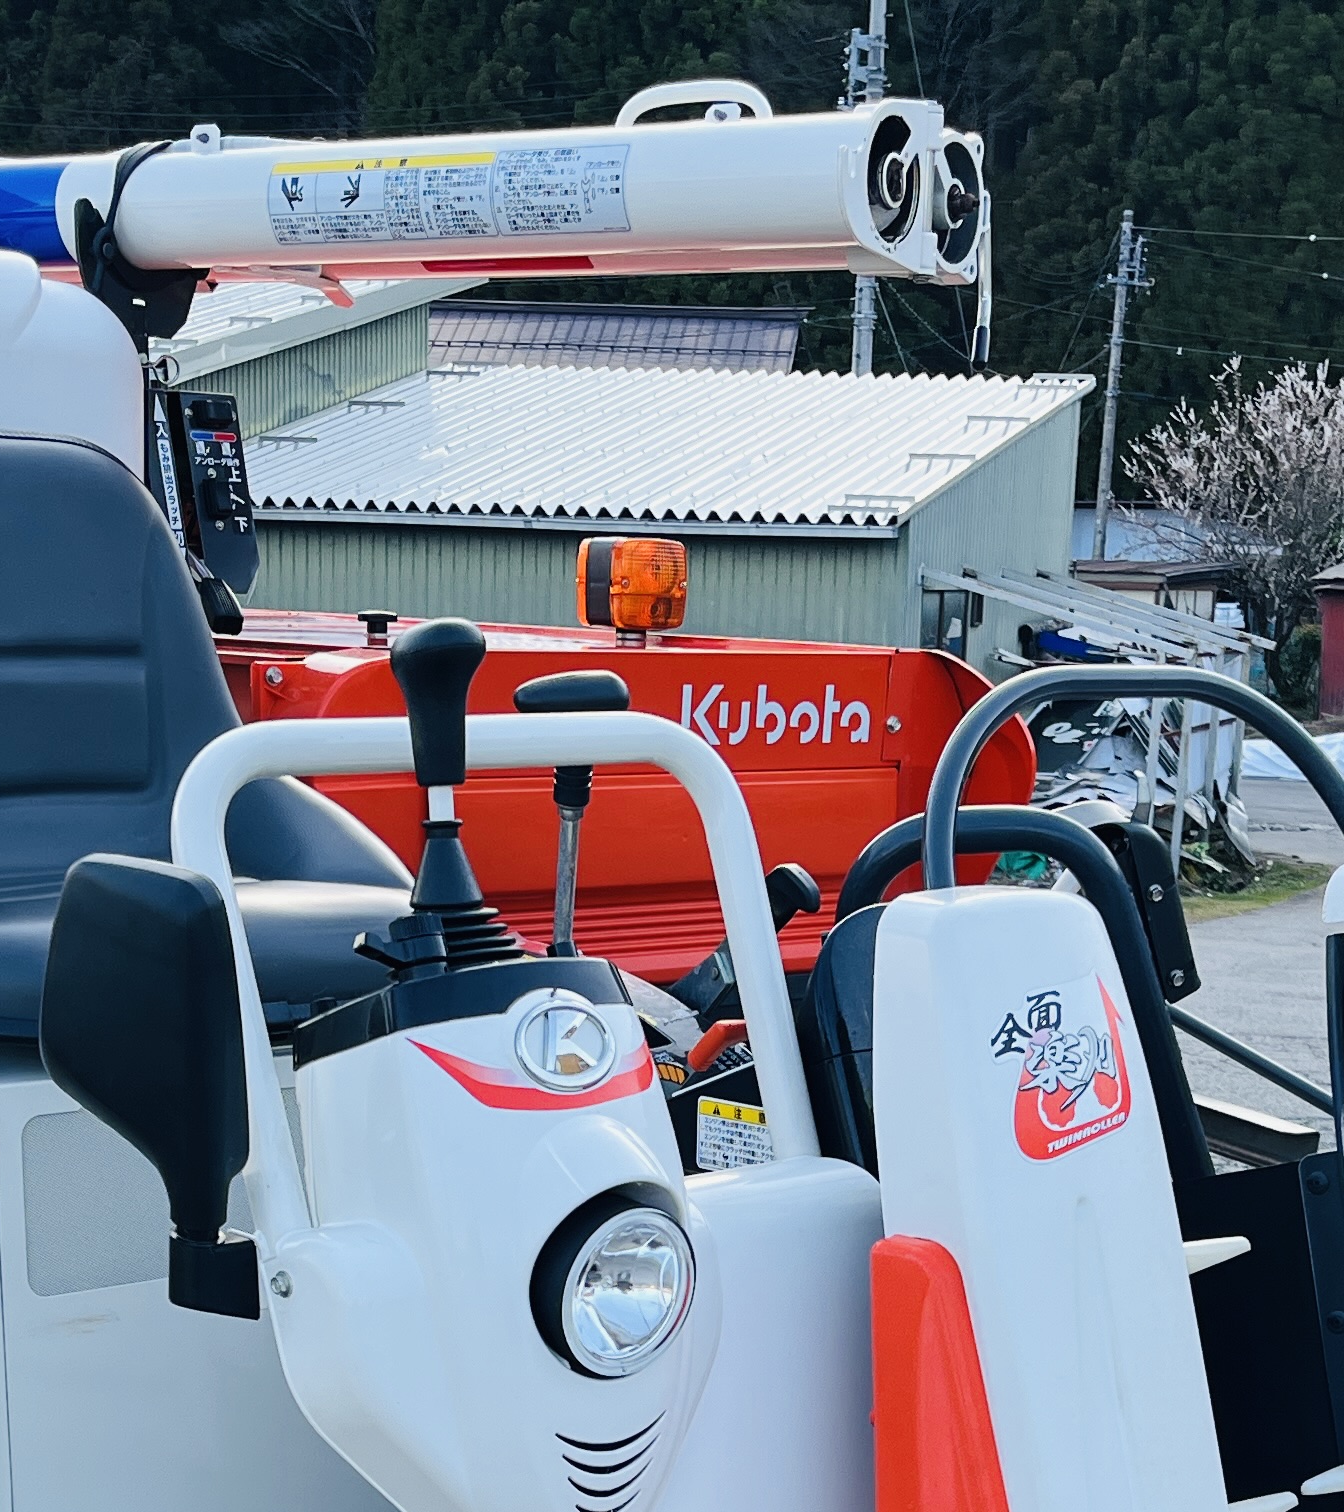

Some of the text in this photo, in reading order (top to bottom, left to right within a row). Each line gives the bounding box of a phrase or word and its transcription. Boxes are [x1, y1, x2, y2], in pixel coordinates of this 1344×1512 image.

[228, 466, 242, 483] 上
[233, 516, 249, 533] 下
[679, 684, 871, 746] Kubota
[1046, 1111, 1128, 1154] TWINROLLER
